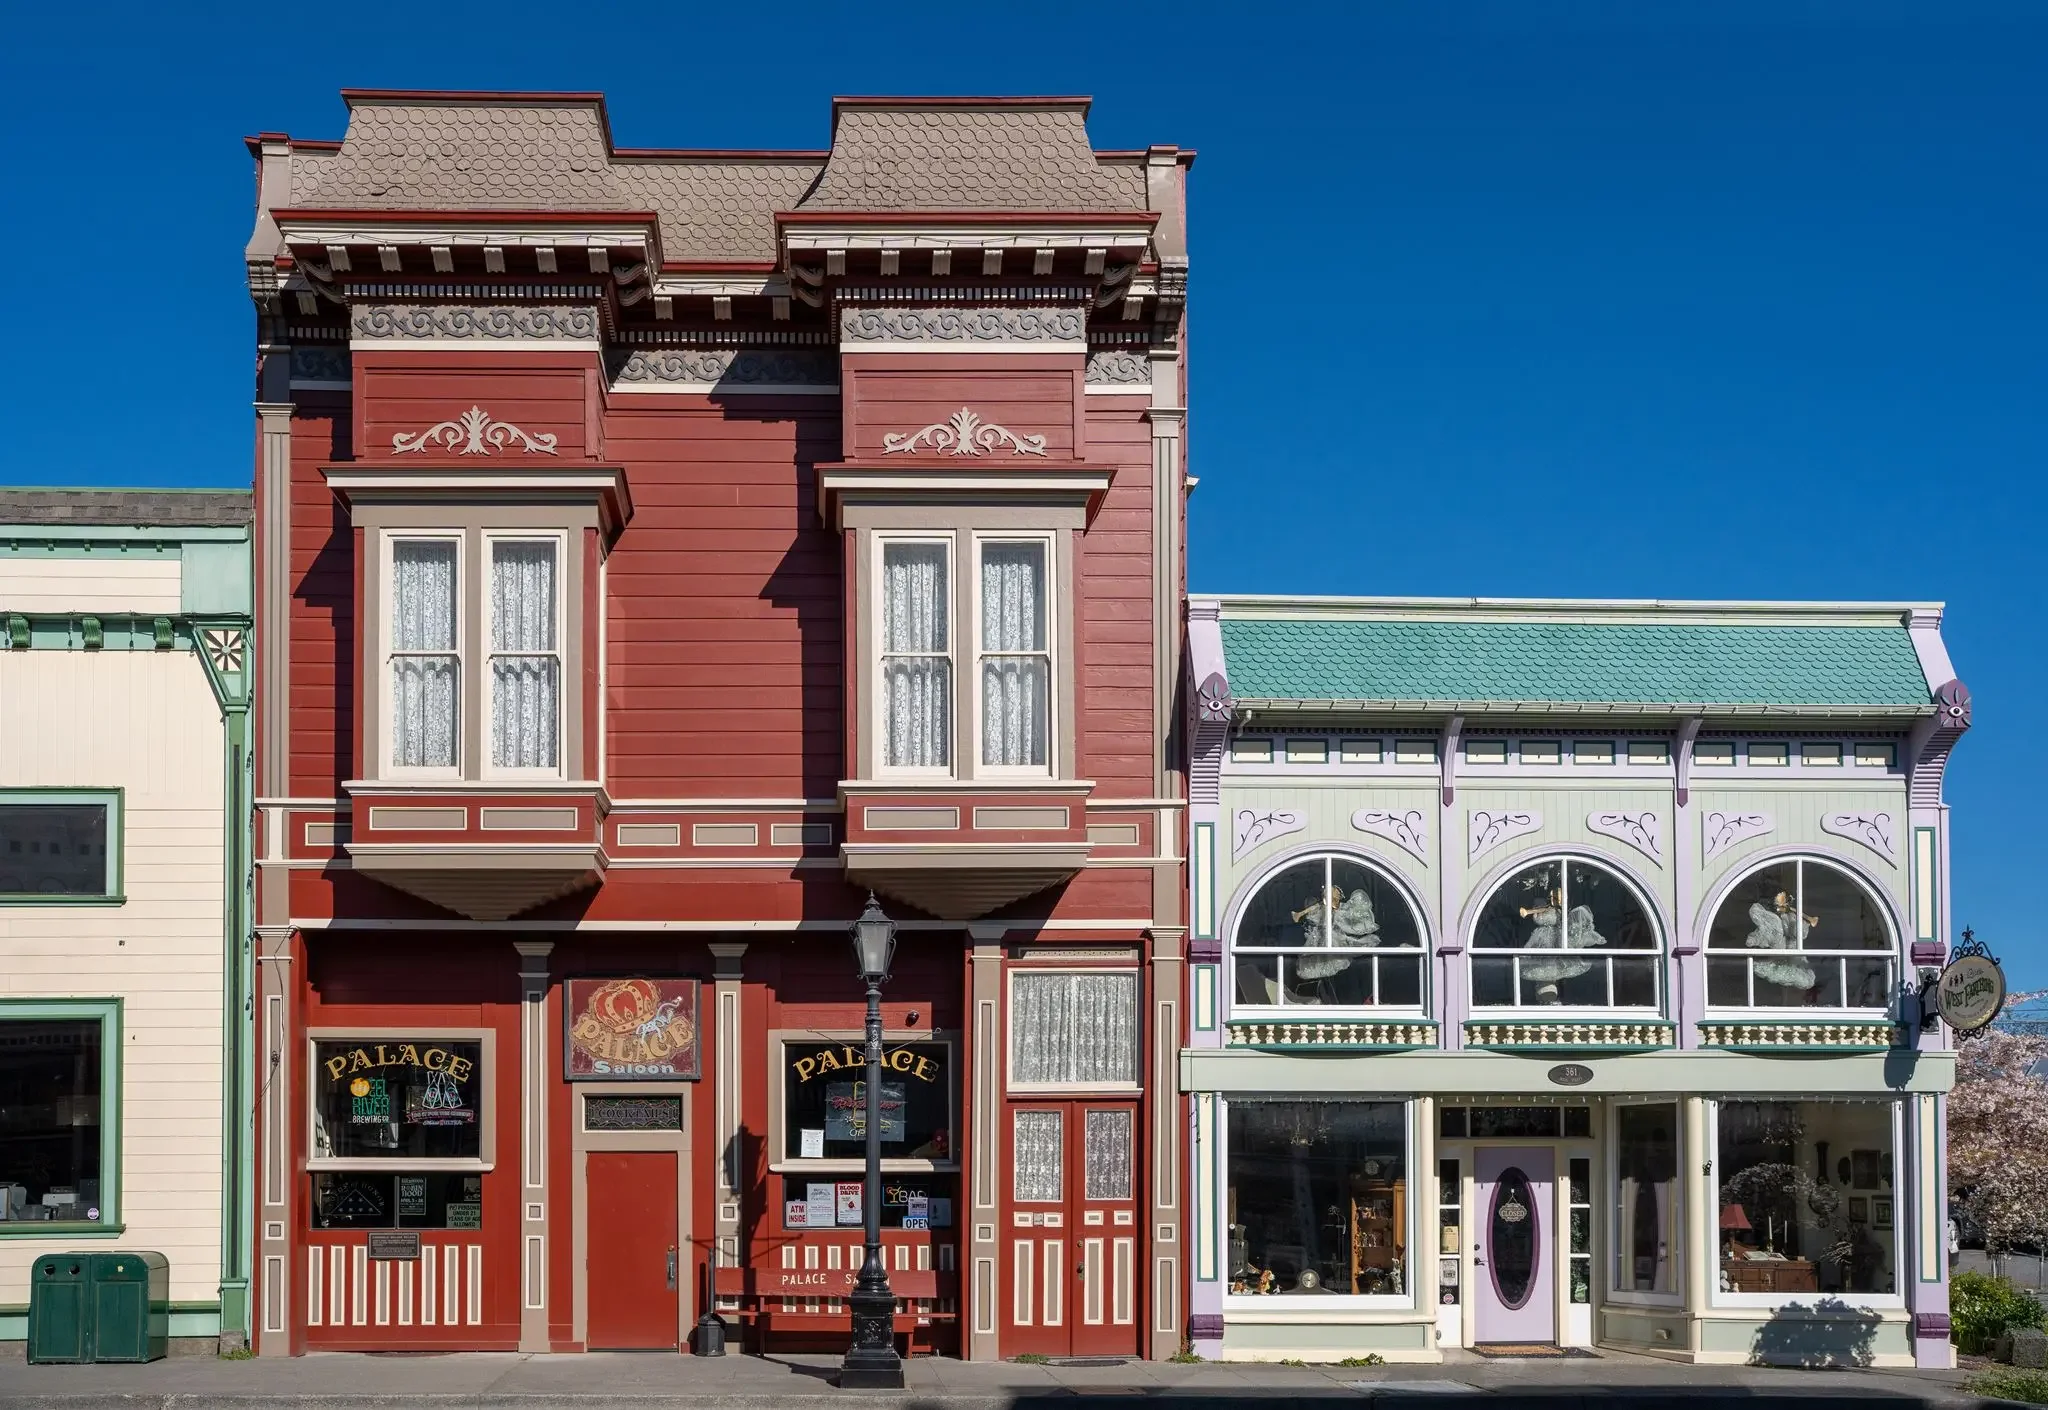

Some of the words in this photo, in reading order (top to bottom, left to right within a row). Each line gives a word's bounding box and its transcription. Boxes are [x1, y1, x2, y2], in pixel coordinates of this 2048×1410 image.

[1944, 989, 1964, 1010] WEST
[572, 1017, 693, 1061] PALACE
[325, 1044, 473, 1083] PALACE
[593, 1060, 675, 1073] Saloon
[1565, 1067, 1577, 1076] 361
[352, 1097, 390, 1115] RIVER
[599, 1108, 669, 1118] COCKTAILS
[352, 1115, 381, 1123] BREWING
[791, 1205, 805, 1213] ATM
[906, 1218, 929, 1229] OPEN
[782, 1274, 827, 1285] PALACE
